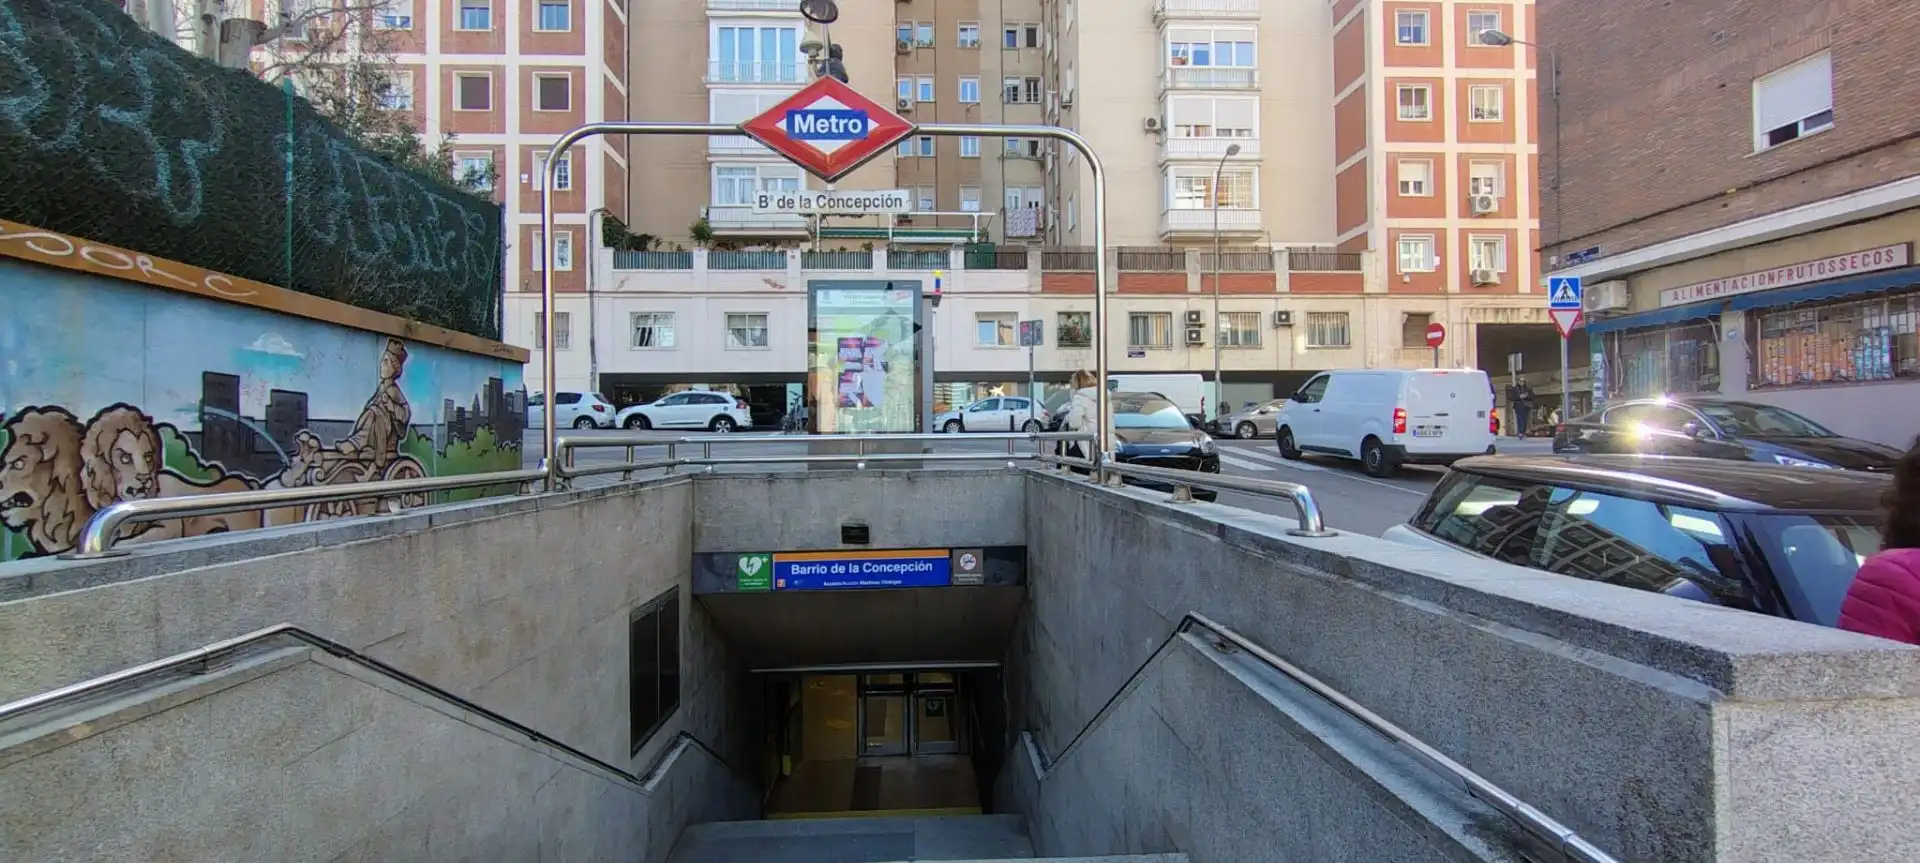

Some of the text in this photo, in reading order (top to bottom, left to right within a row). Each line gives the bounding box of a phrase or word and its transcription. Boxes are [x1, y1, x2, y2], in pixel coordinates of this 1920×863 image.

[794, 114, 863, 134] Metro
[777, 195, 795, 209] de
[799, 194, 812, 209] la
[816, 193, 903, 211] Concepción
[791, 560, 933, 575] Barrio de la Concepción
